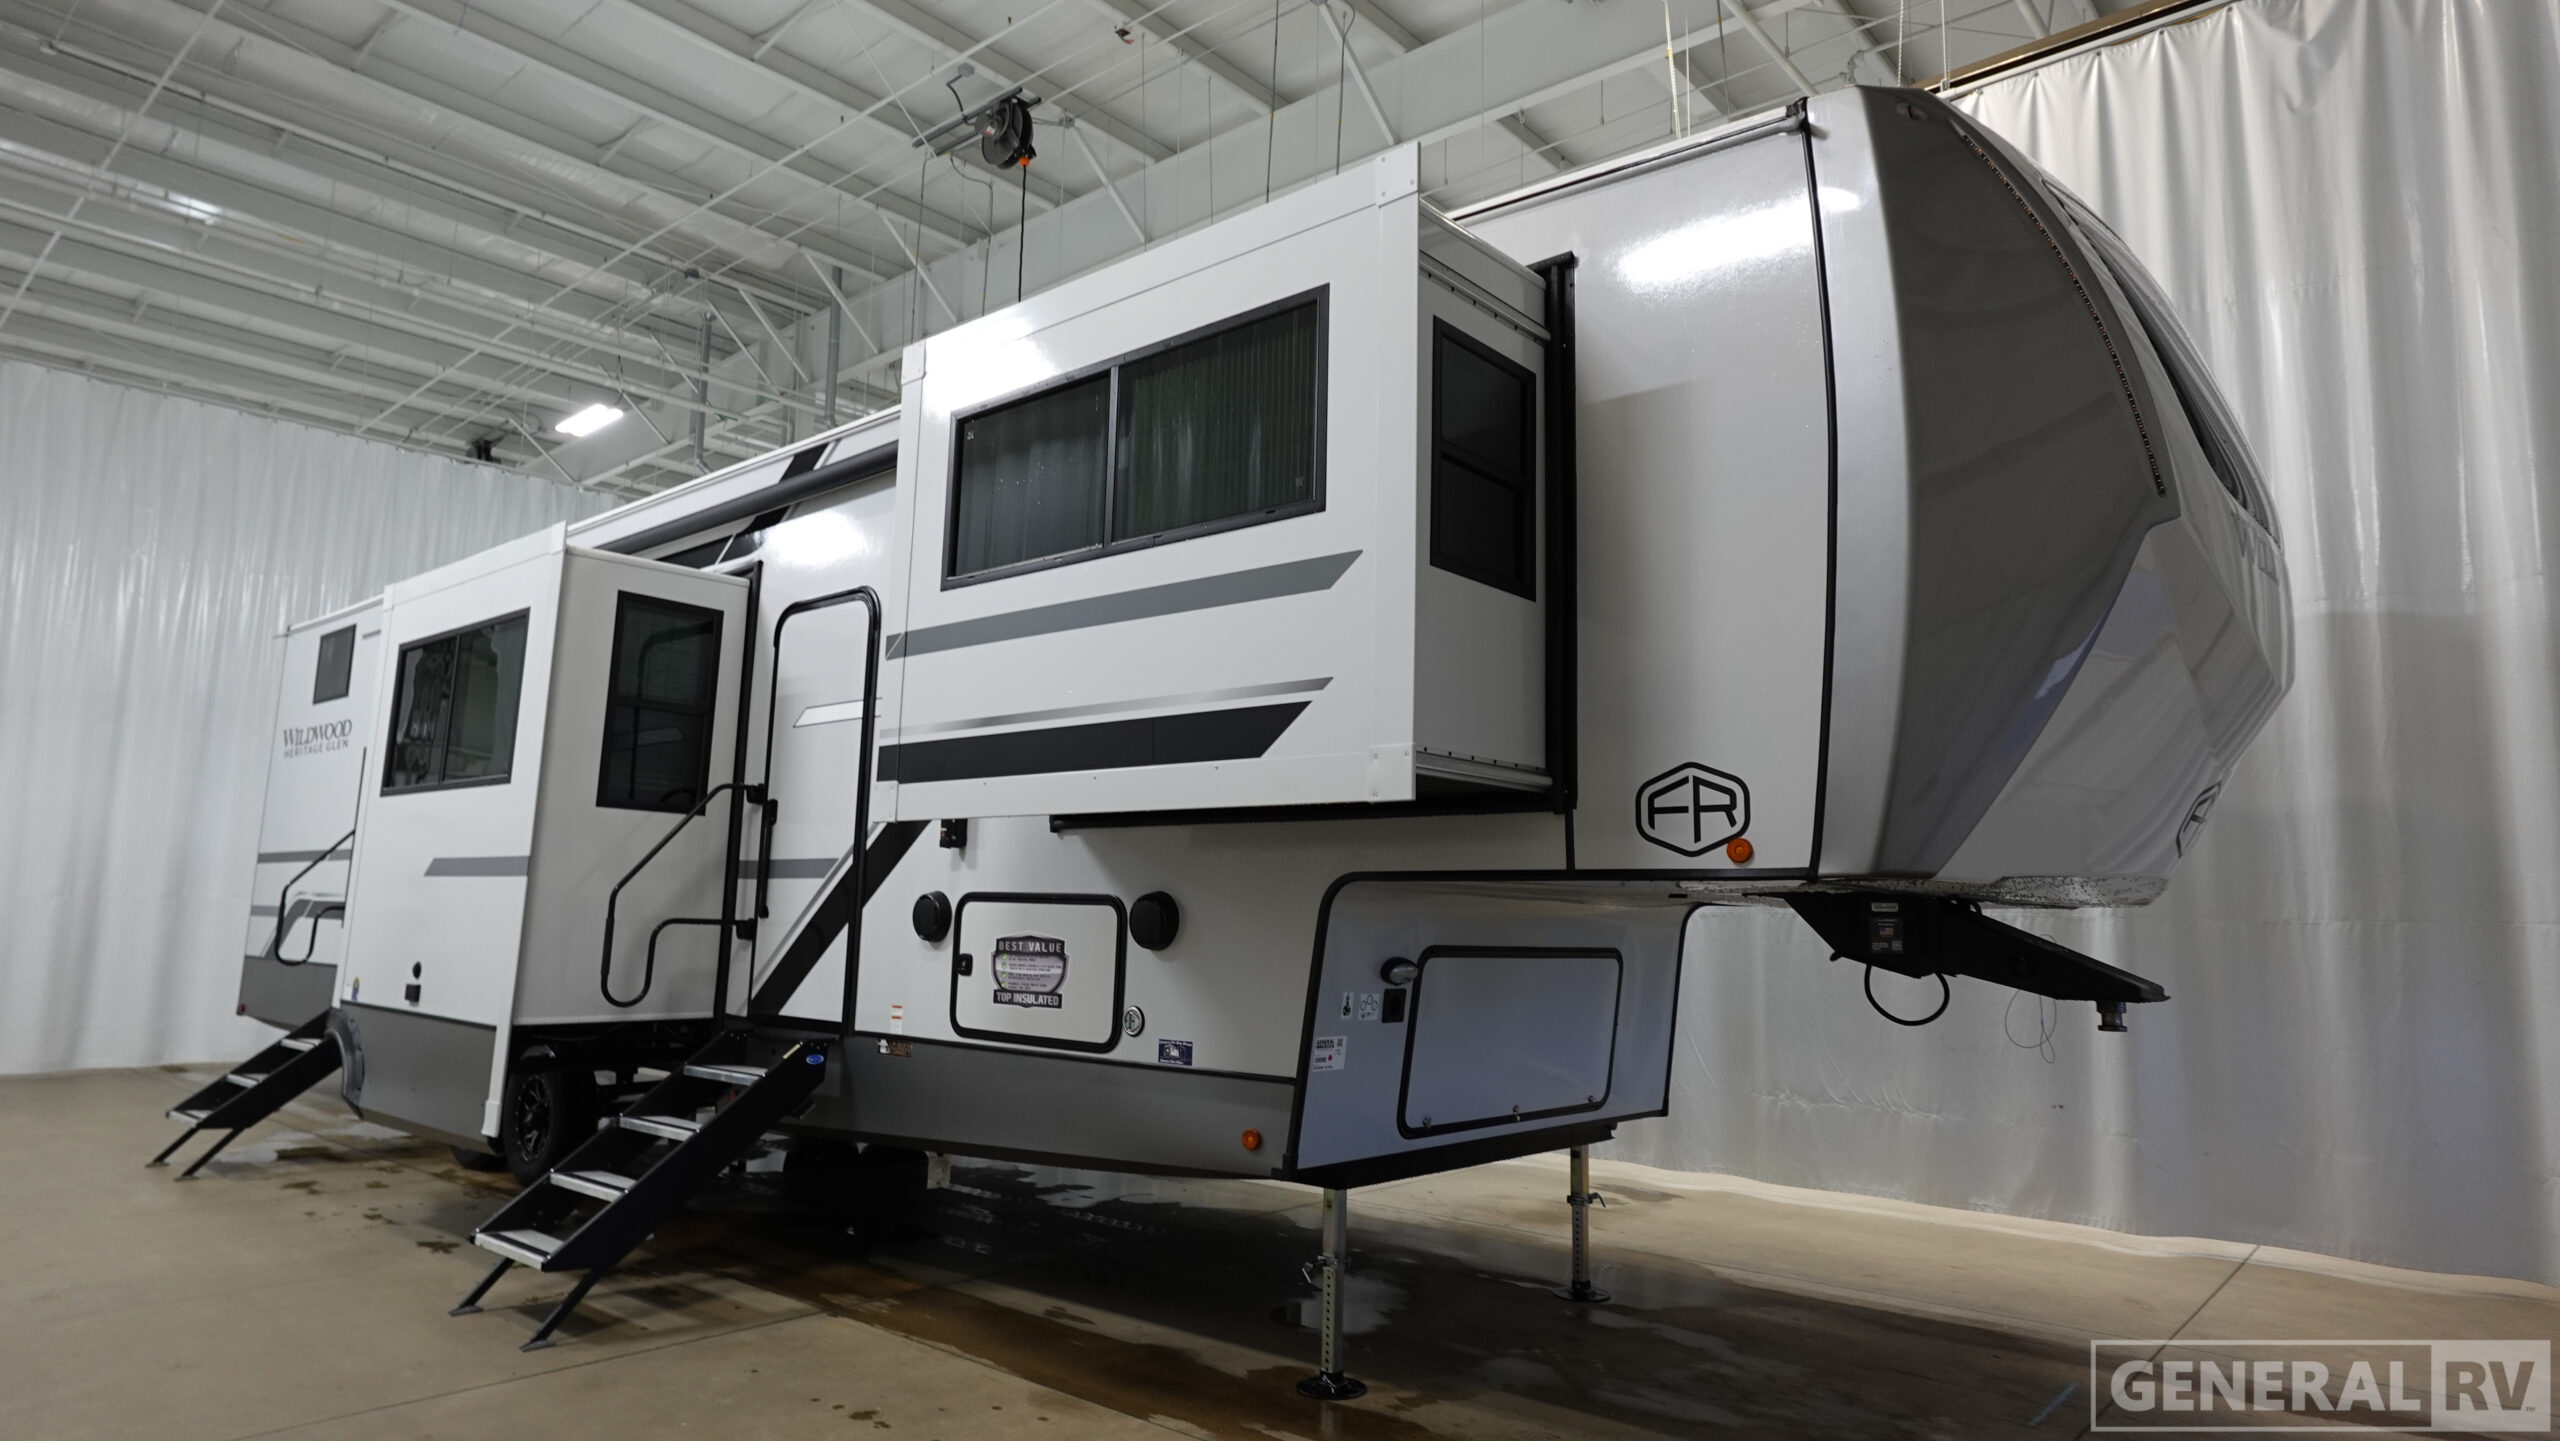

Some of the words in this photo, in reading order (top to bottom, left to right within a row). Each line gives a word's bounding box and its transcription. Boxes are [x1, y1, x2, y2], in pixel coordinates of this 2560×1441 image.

[283, 719, 352, 747] WILDWOOD
[284, 743, 323, 758] HERITAGE
[326, 739, 349, 752] GLEN
[1648, 775, 1737, 844] FR
[998, 940, 1024, 951] BEST
[1028, 942, 1062, 953] VALUE
[996, 991, 1012, 1002] TOP
[1013, 993, 1059, 1006] INSULATED
